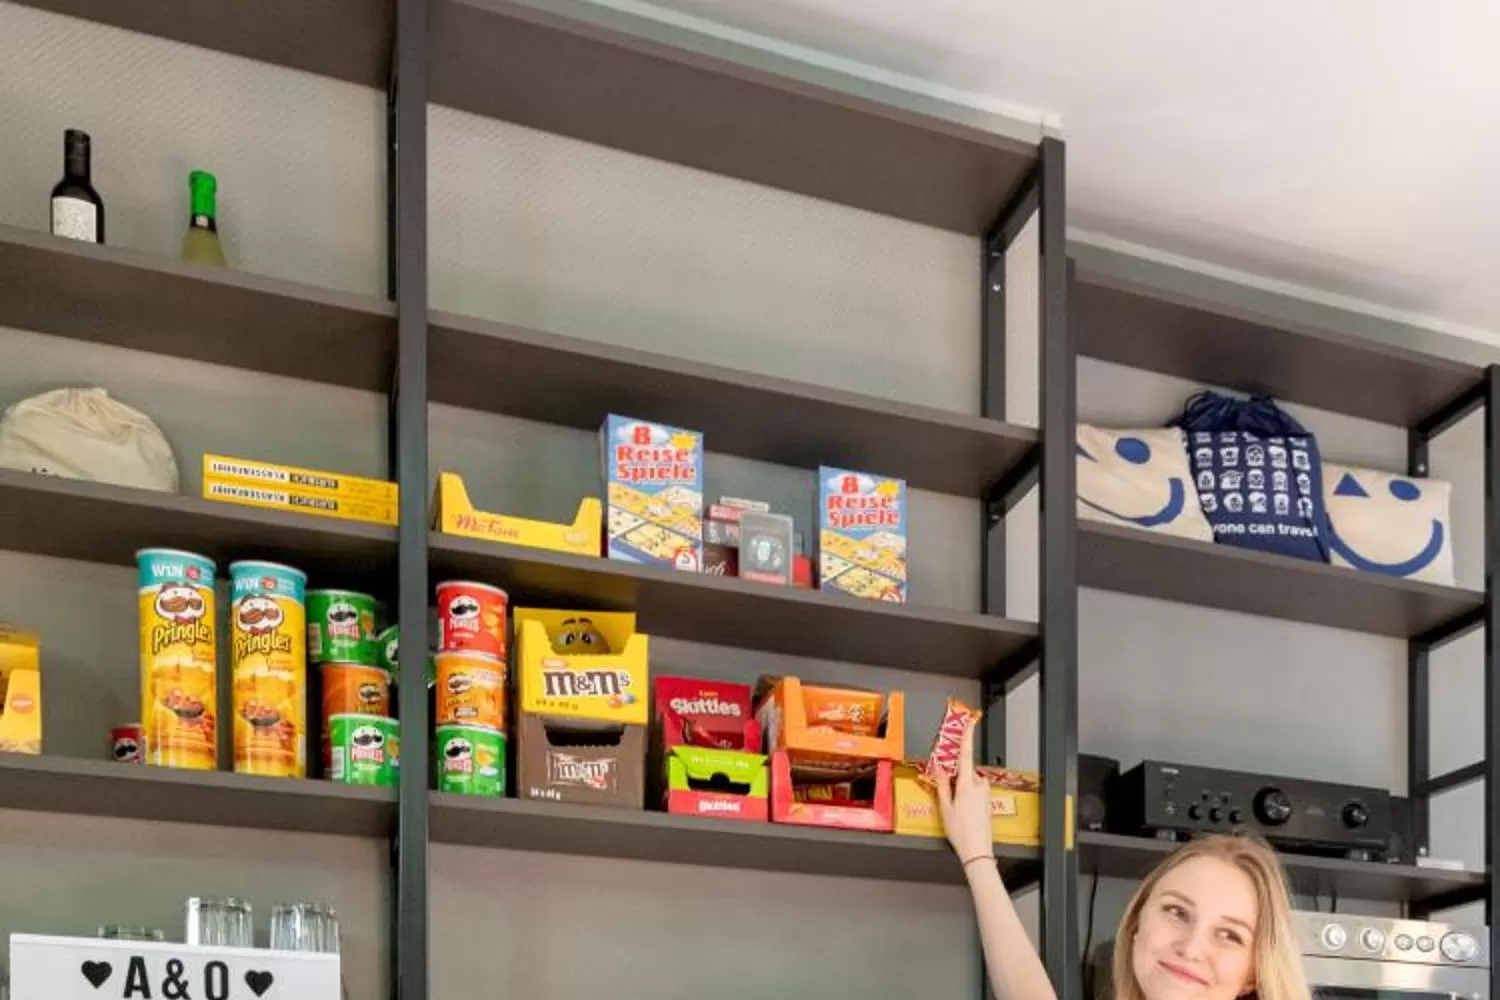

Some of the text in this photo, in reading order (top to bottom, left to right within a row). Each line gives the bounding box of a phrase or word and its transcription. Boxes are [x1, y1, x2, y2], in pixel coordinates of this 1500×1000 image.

[616, 445, 689, 462] Reise
[617, 463, 696, 482] Spiele
[827, 495, 893, 509] Reise
[828, 510, 900, 528] Spiele
[1248, 523, 1275, 535] can
[151, 563, 183, 578] WIN
[235, 577, 260, 592] WIN
[235, 629, 291, 663] Pringles
[669, 698, 741, 717] Skittles
